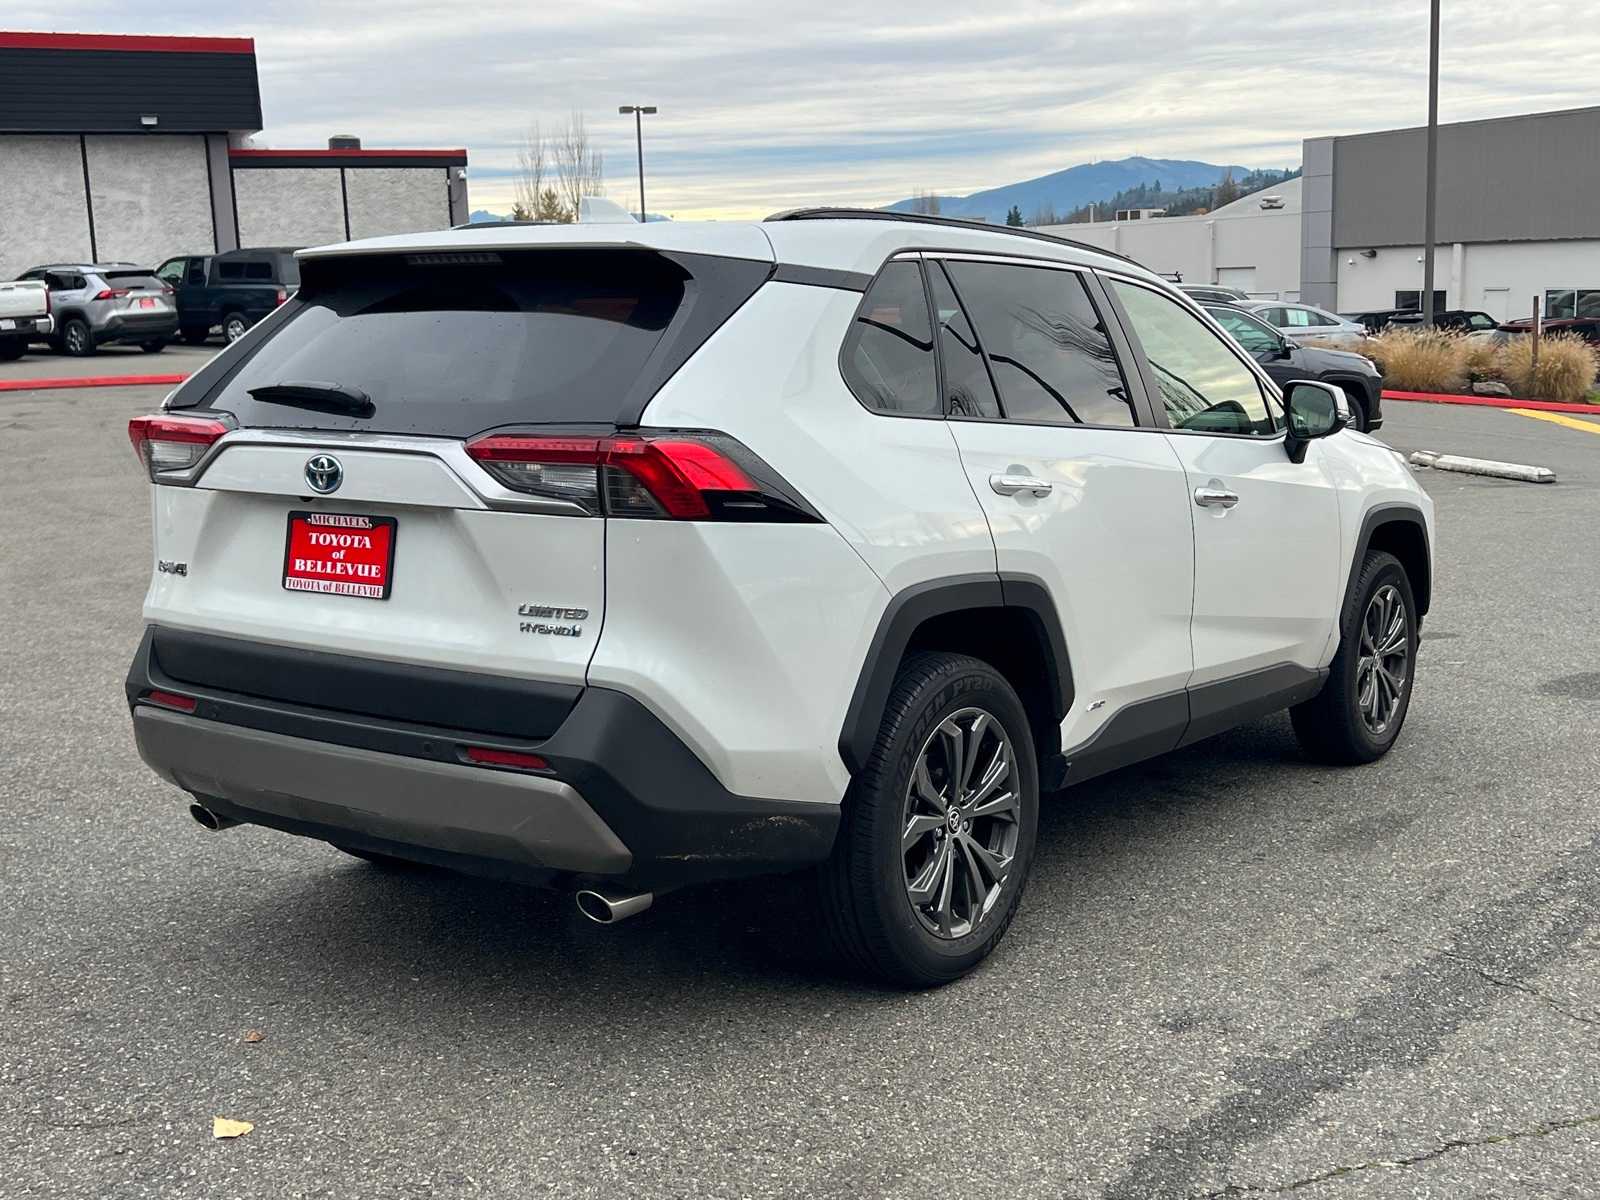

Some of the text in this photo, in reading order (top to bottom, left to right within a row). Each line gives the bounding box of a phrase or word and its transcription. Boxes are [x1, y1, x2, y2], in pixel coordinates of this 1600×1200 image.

[308, 532, 372, 549] TOYOTA
[331, 550, 346, 560] of
[294, 559, 381, 578] BELLEVUE
[287, 578, 321, 592] TOYOTA
[323, 583, 334, 592] of
[334, 583, 383, 598] BELLEVUE
